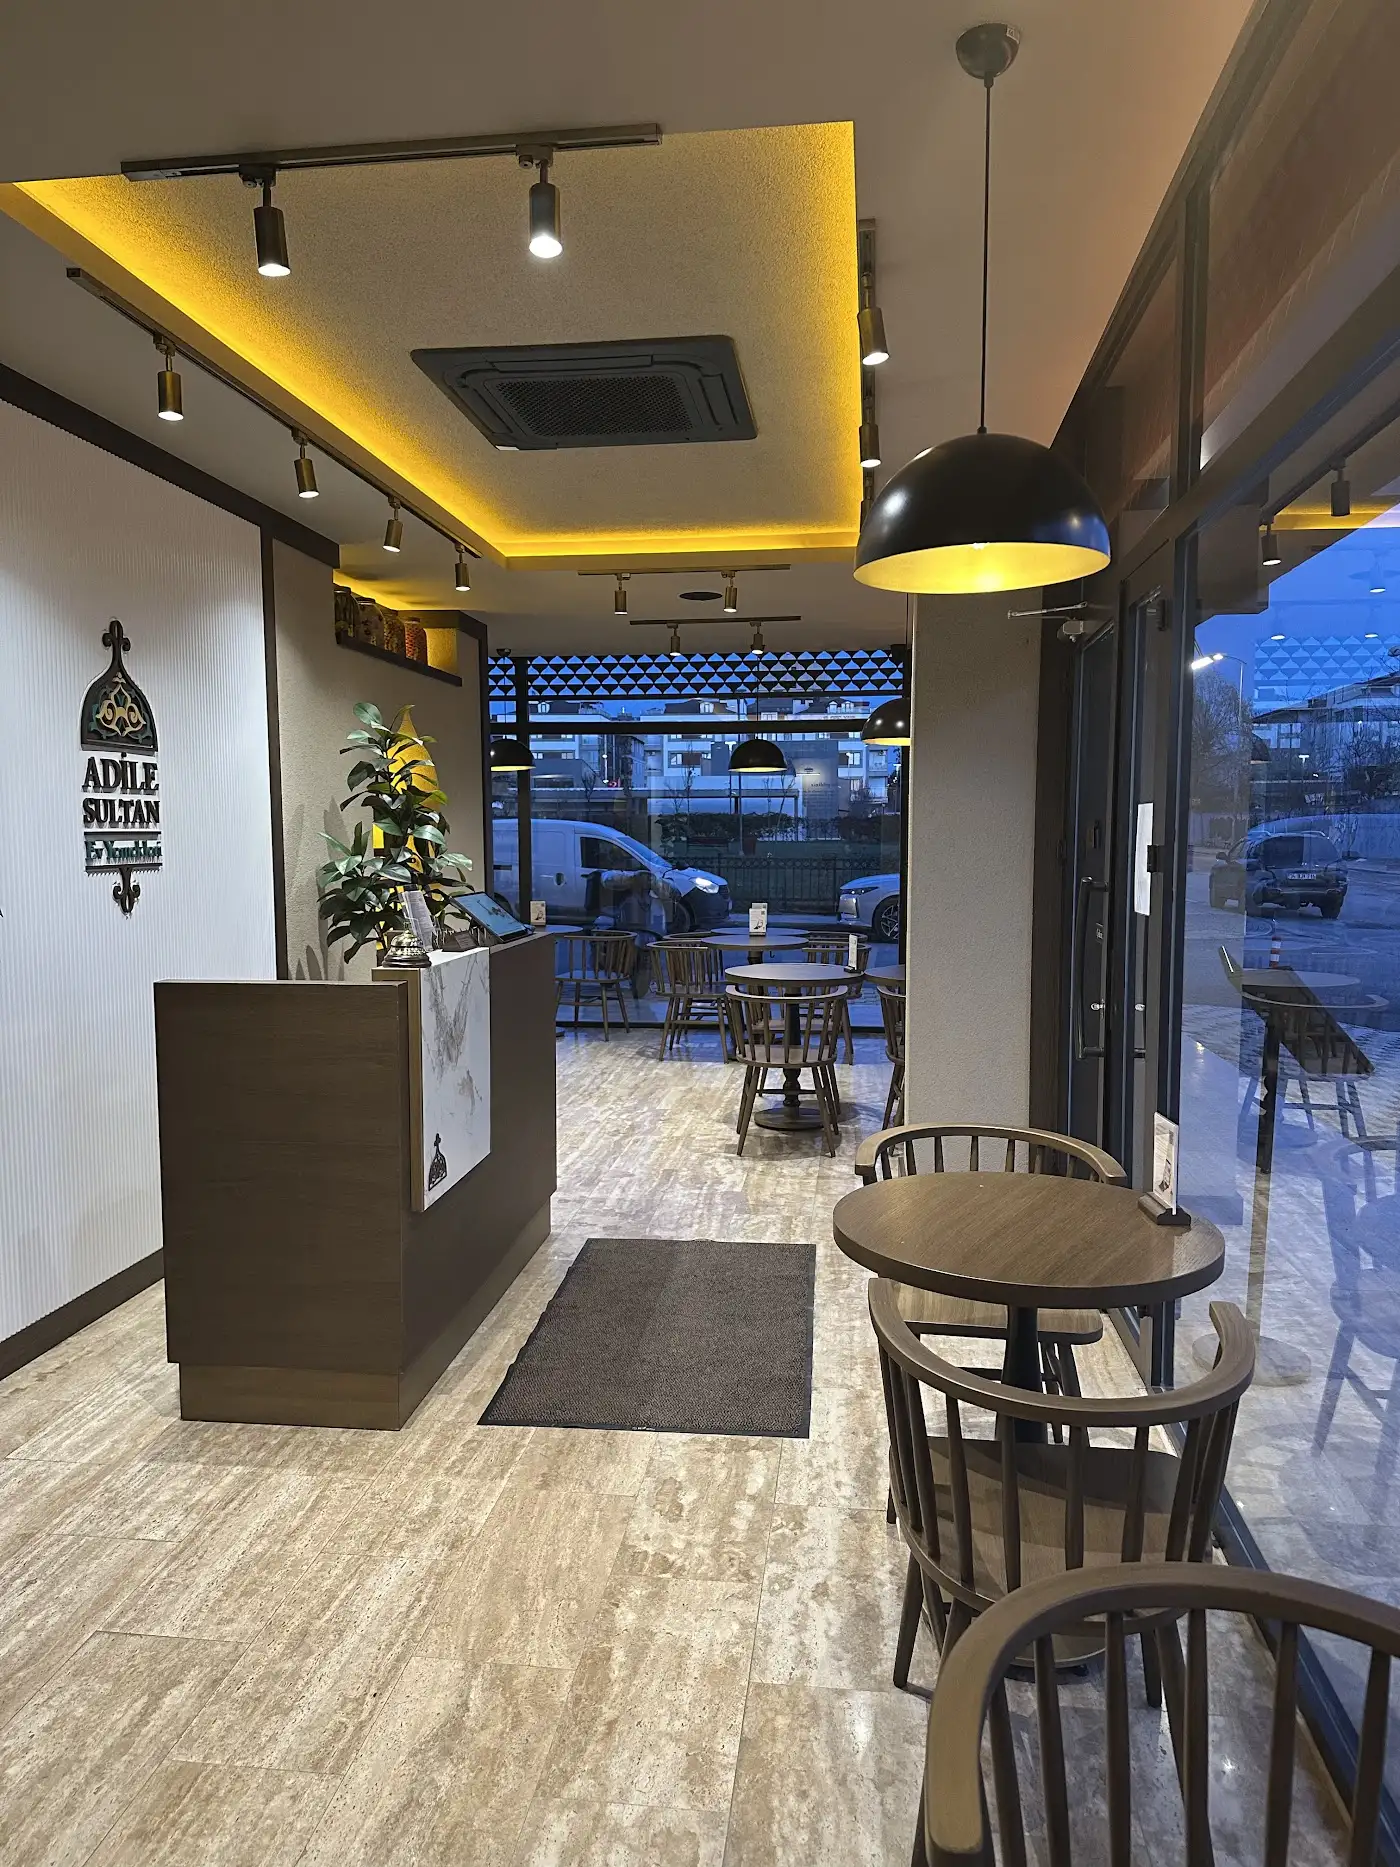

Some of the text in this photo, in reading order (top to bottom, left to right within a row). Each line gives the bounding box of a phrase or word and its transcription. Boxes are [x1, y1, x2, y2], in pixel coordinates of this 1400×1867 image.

[82, 752, 159, 791] ADİLE
[83, 798, 160, 824] SULTAN
[84, 840, 105, 860] Ev
